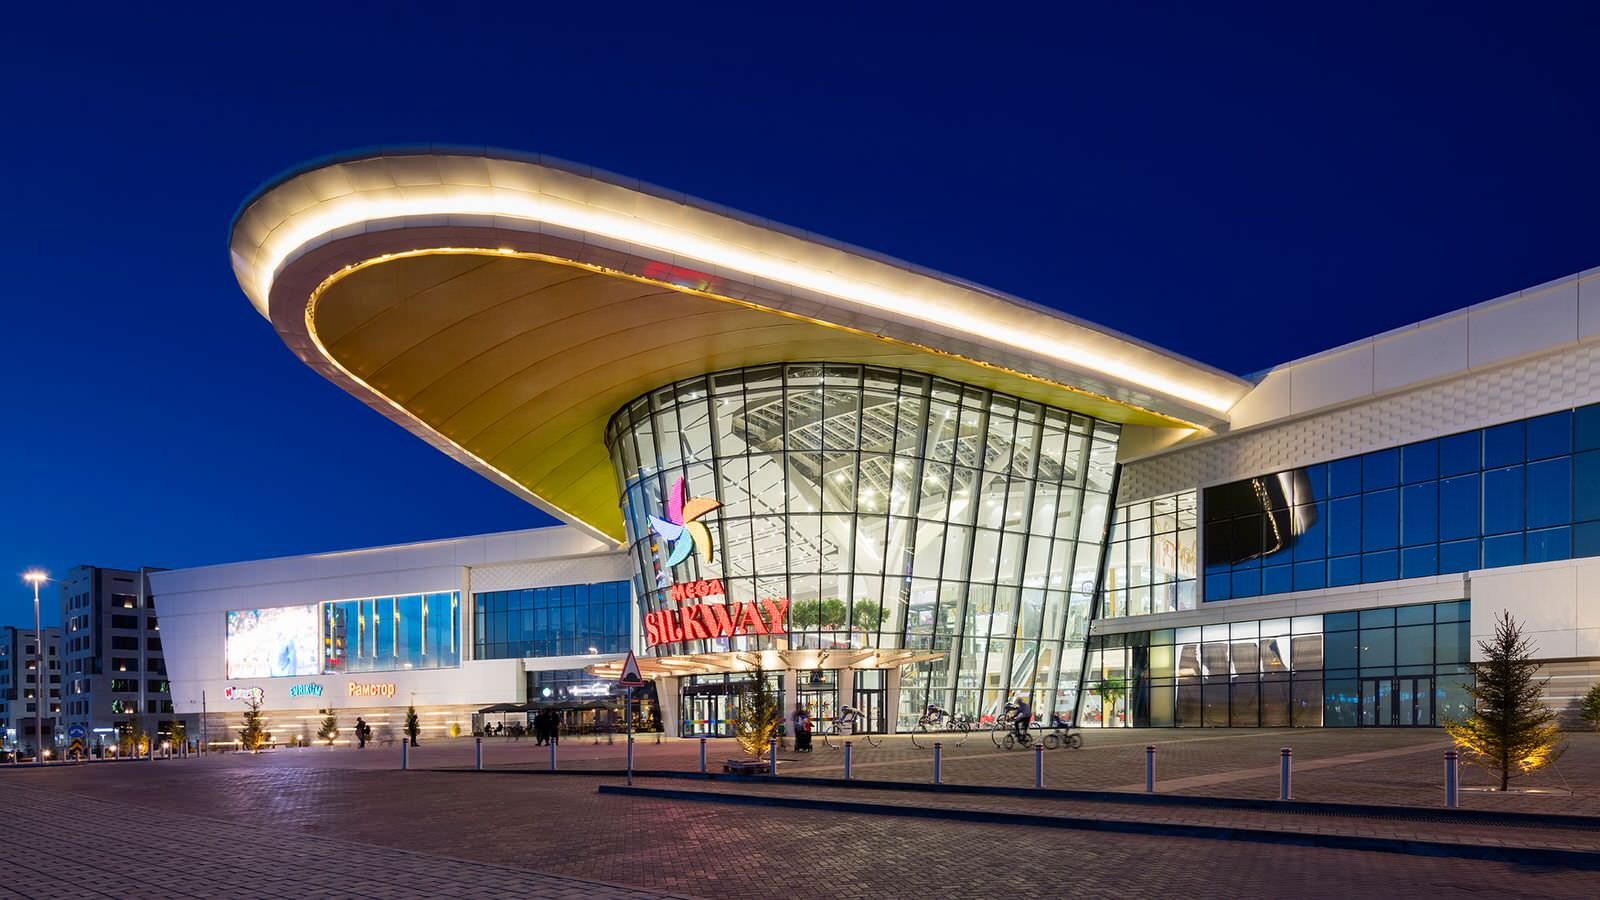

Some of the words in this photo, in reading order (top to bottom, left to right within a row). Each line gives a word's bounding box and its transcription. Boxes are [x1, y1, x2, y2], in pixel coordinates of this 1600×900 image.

[671, 579, 725, 601] MEGA
[645, 598, 789, 647] SILKWAY
[348, 681, 396, 699] Рамстор
